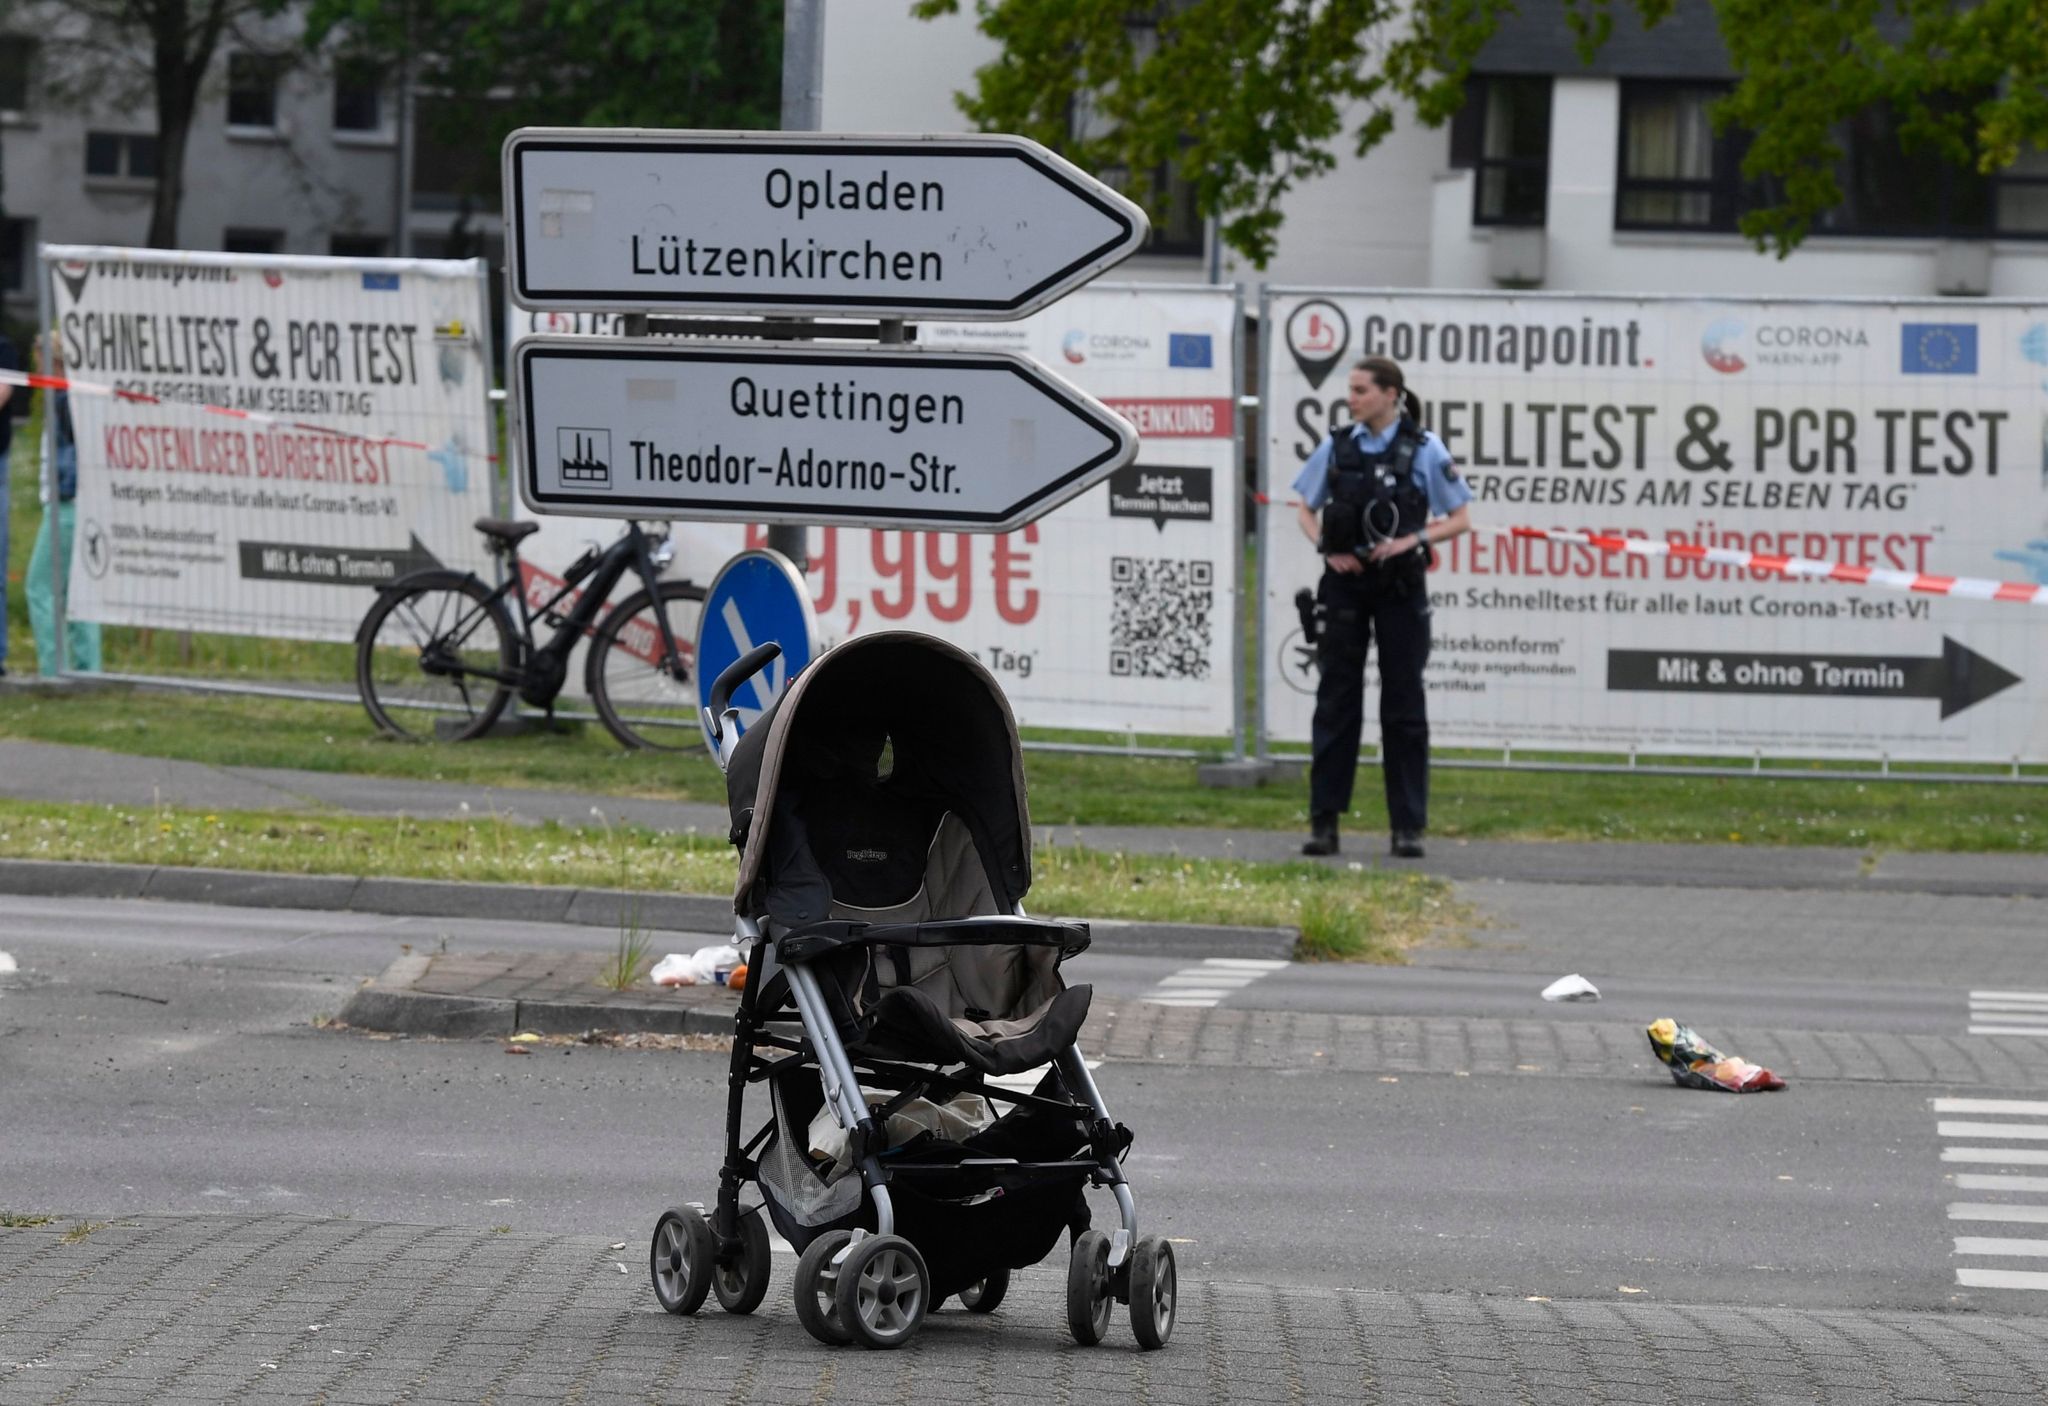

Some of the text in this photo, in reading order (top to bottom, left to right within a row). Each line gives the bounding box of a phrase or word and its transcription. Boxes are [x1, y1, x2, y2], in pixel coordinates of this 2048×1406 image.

[763, 168, 945, 219] Opladen
[631, 235, 944, 281] Lützenkirchen
[64, 311, 417, 385] SCHNELLTEST & PCR TEST
[1364, 315, 1653, 372] Coronapoint.
[1755, 326, 1870, 347] CORONA
[730, 376, 964, 432] Quettingen
[1676, 404, 1734, 473] &
[1754, 407, 1857, 474] PCR
[1875, 409, 2009, 476] TEST
[629, 440, 962, 494] Theodor-Adorno-Str.
[1136, 473, 1184, 495] Jetzt
[1635, 479, 1692, 507] AM
[1701, 480, 1831, 509] SELBEN
[1466, 587, 1598, 614] Schnelltest
[1604, 590, 1638, 613] für
[1645, 593, 1689, 614] alle
[1695, 594, 1743, 616] laut
[1750, 596, 1931, 620] Corona-Test-V!
[1657, 657, 1905, 689] Mit & ohne Termin
